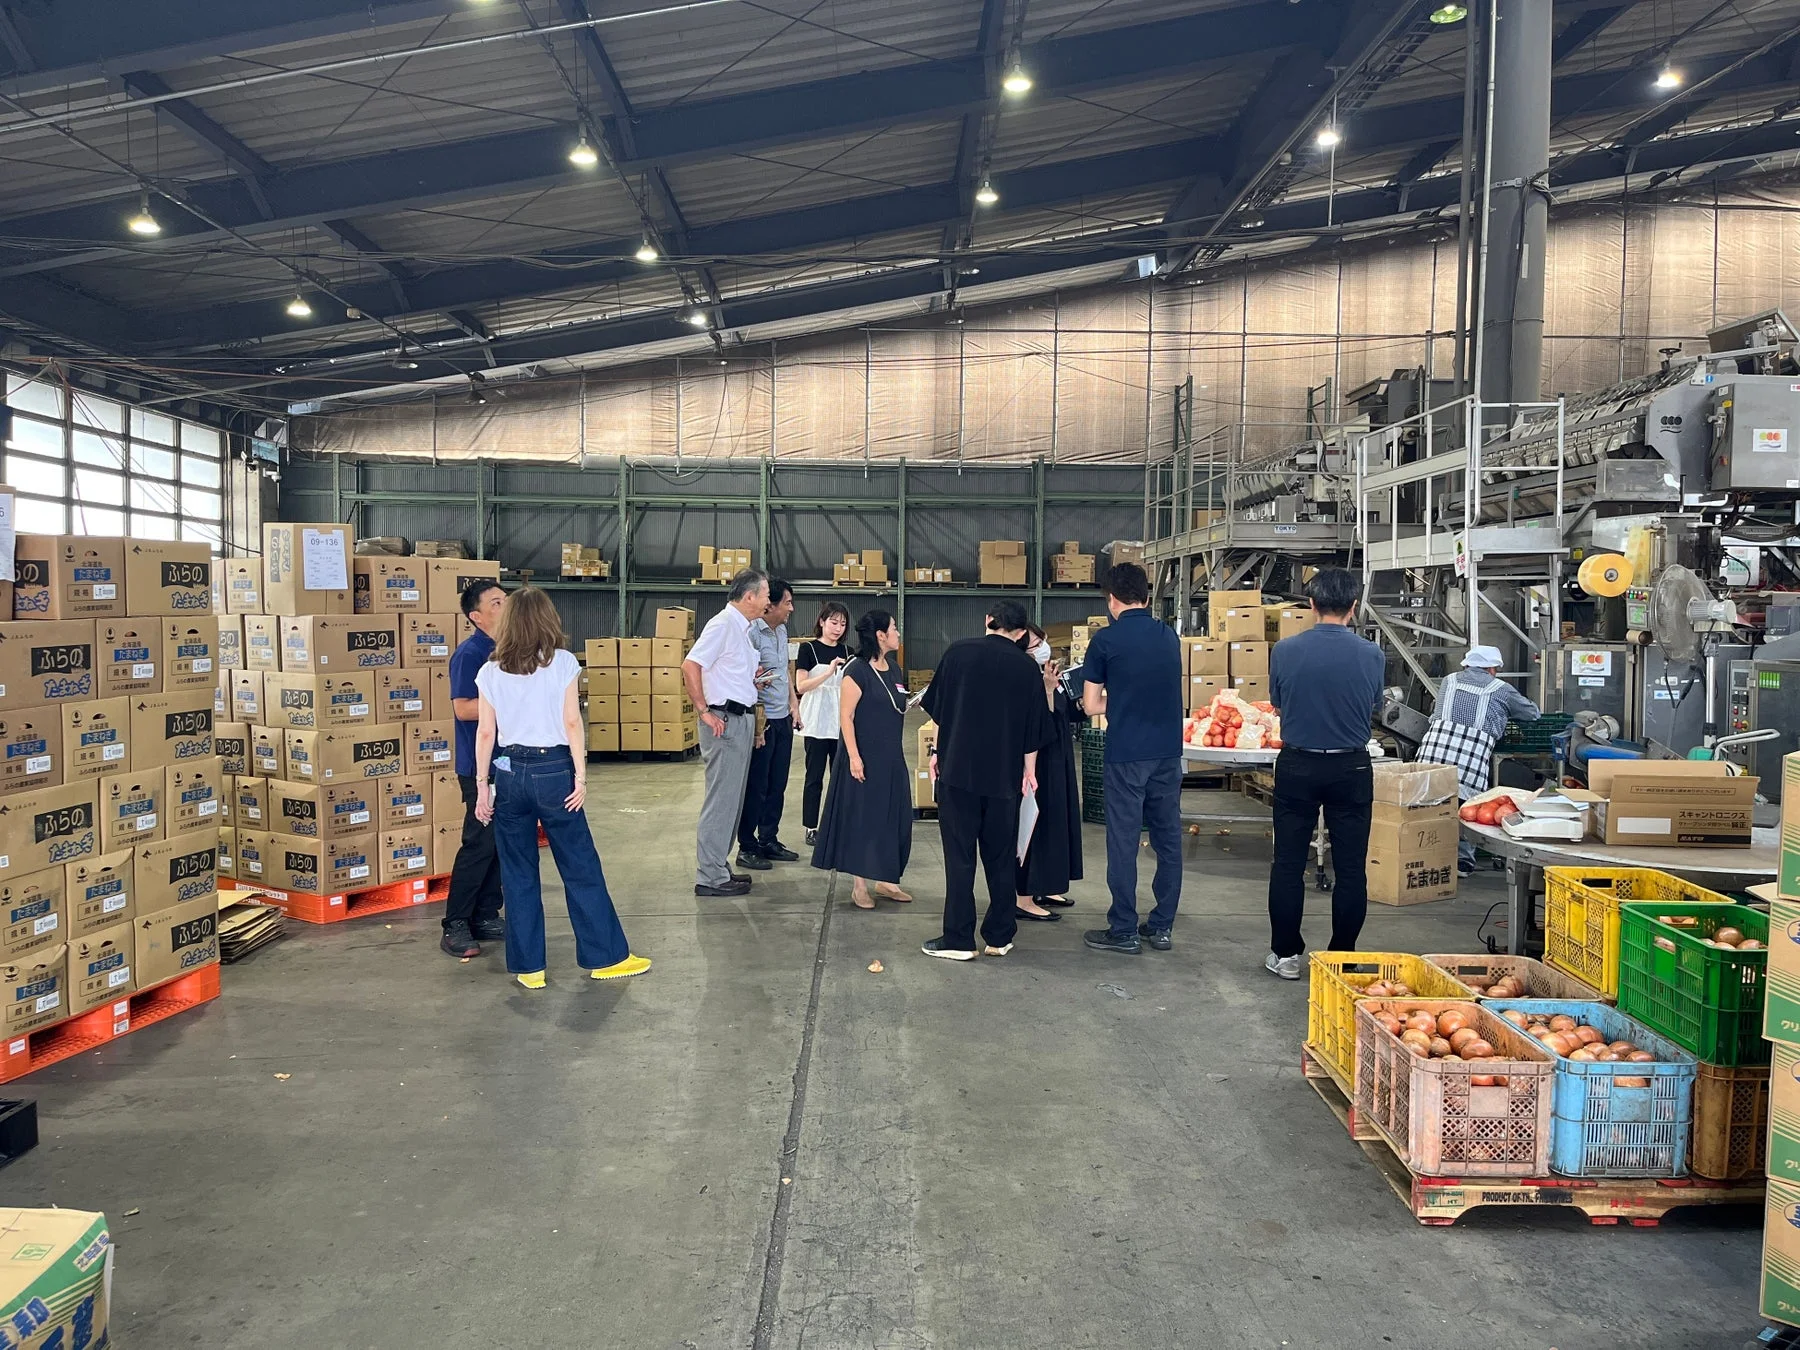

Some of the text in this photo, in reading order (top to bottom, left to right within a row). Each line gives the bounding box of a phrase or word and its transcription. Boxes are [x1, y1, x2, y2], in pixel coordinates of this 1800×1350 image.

[310, 538, 339, 546] 09-136
[169, 565, 203, 583] ふらの
[355, 632, 389, 646] ふらの
[41, 647, 83, 669] ふらの
[173, 713, 206, 733] ふらの
[361, 742, 393, 758] ふらの
[286, 801, 311, 816] ふらの
[45, 808, 84, 834] ふらの
[177, 852, 210, 876] ふらの
[289, 855, 312, 870] ふらの
[1406, 865, 1451, 890] たまねぎ
[179, 919, 211, 944] ふらの
[1482, 1191, 1511, 1203] PRODUCT
[1513, 1191, 1521, 1203] OF
